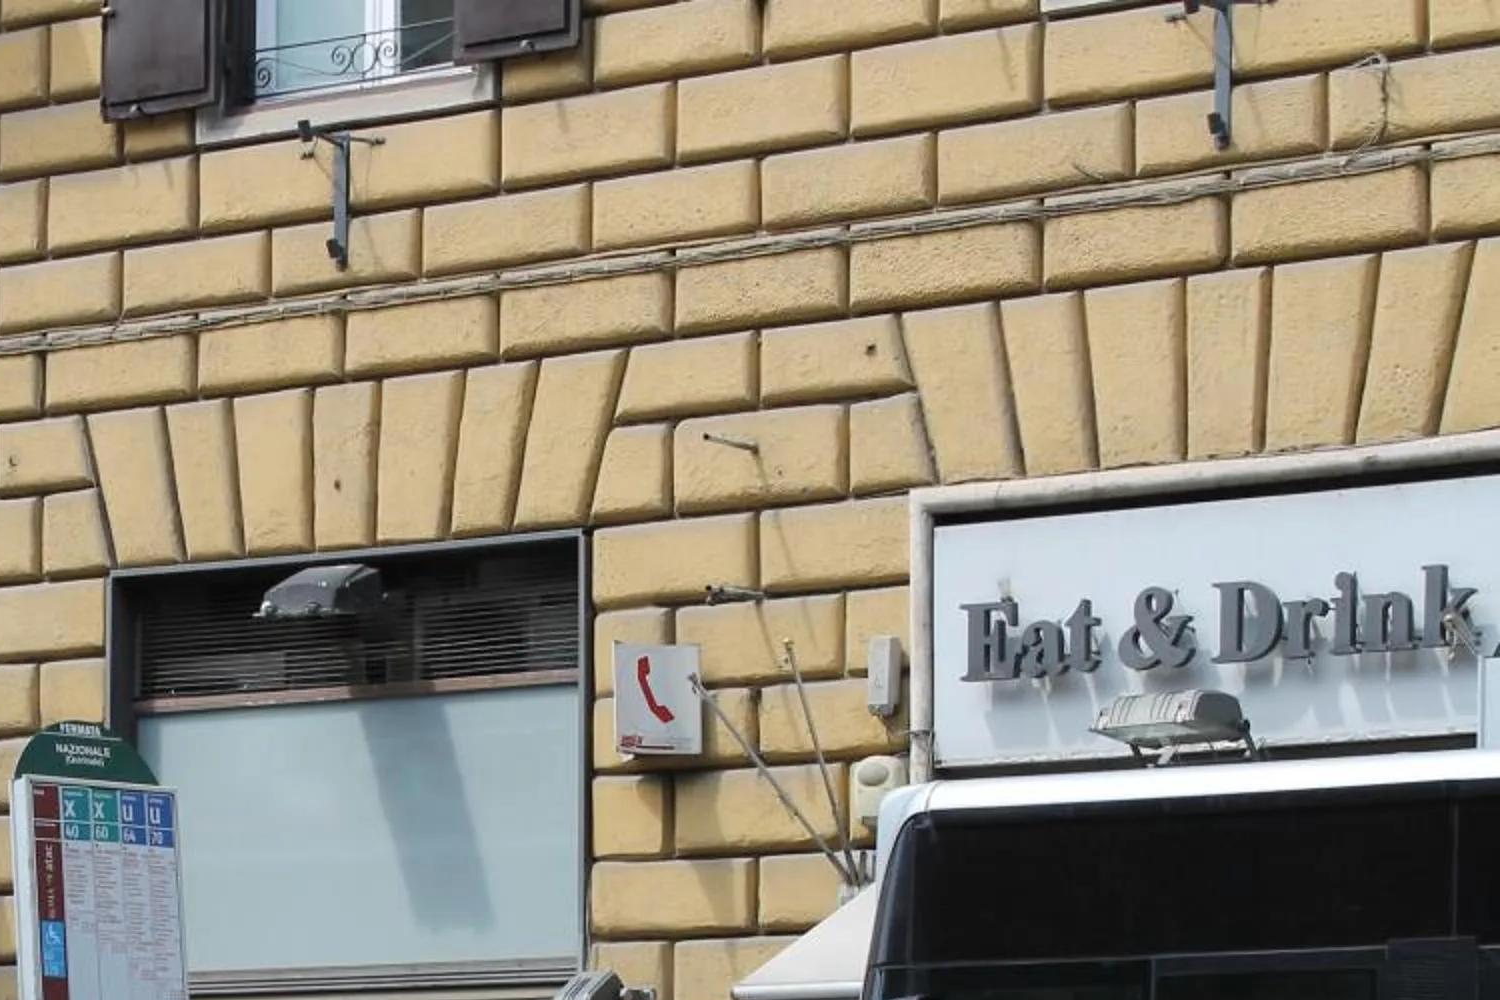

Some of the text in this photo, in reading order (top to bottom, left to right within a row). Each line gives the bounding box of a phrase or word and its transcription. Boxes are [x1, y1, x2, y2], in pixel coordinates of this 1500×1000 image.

[959, 563, 1482, 682] Eat & Drink
[55, 743, 111, 758] NAZIONALE
